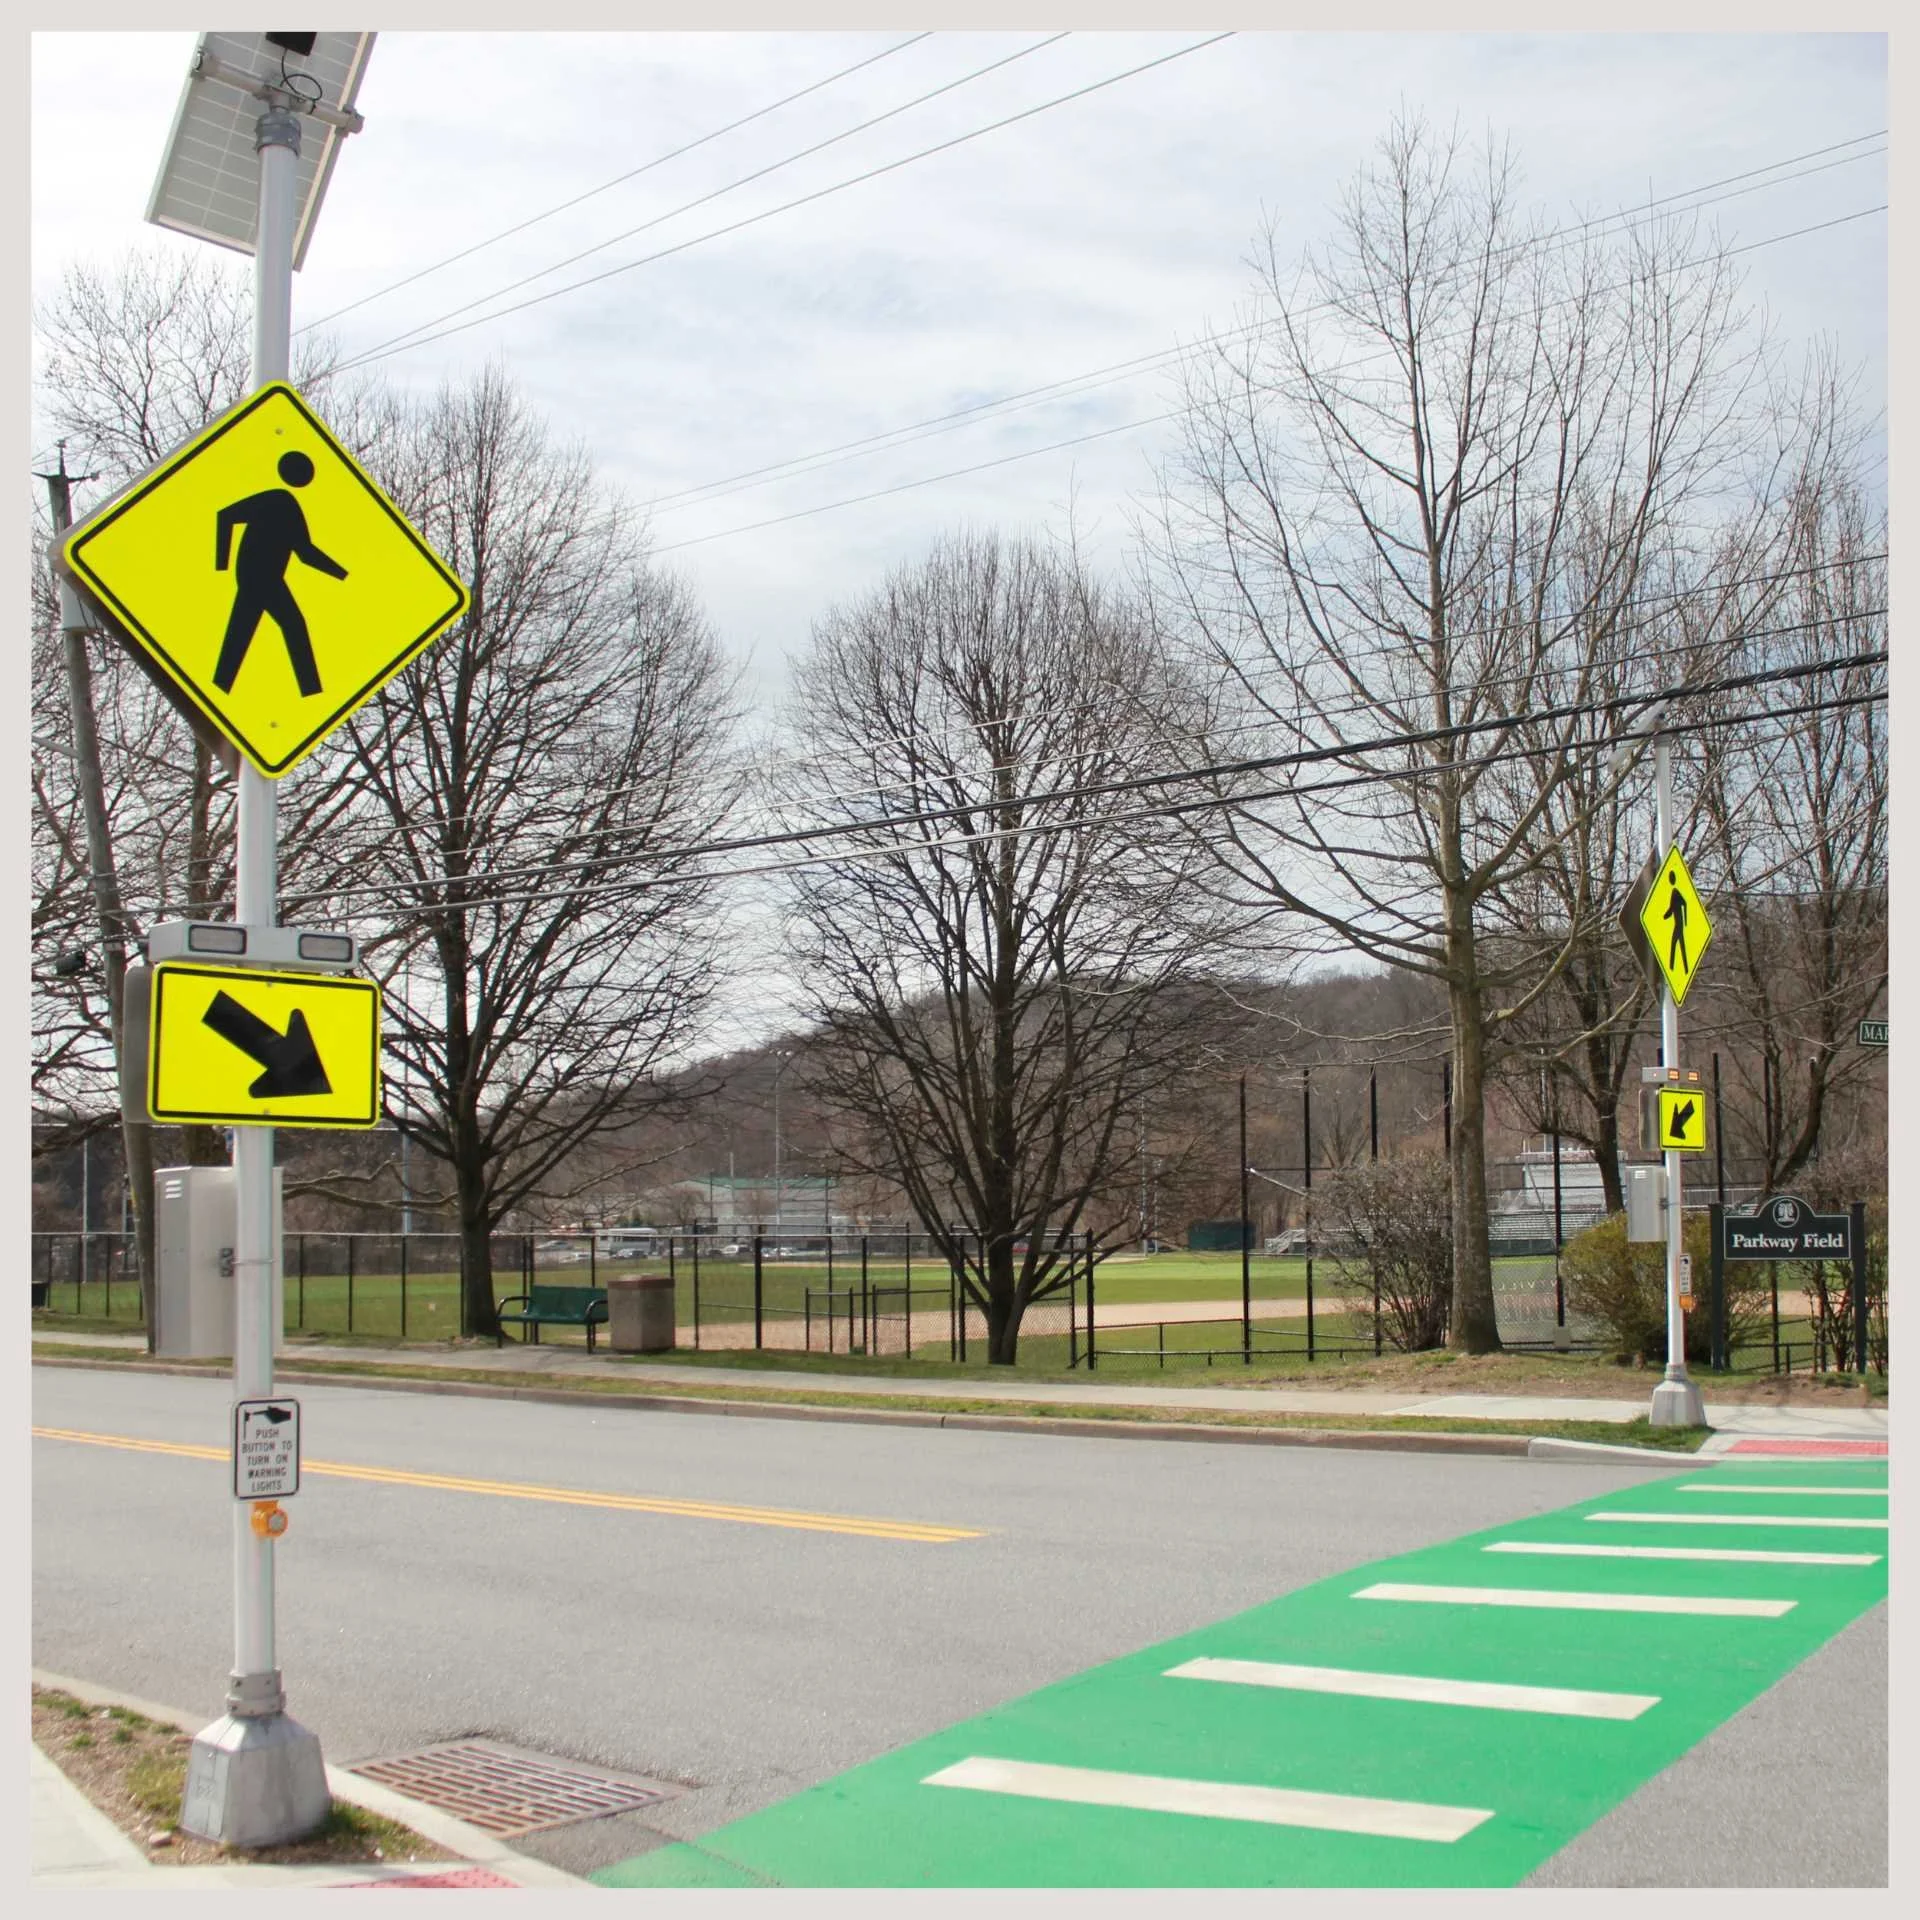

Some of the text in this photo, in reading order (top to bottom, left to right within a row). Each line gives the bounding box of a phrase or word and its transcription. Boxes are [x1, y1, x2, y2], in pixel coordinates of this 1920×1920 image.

[1732, 1233, 1844, 1252] Parkway Field
[255, 1428, 280, 1439] PUSH
[242, 1440, 292, 1453] BUTTON TO
[248, 1454, 288, 1466] TURN ON
[248, 1467, 287, 1479] WARNING
[251, 1480, 282, 1492] LIGHTS
